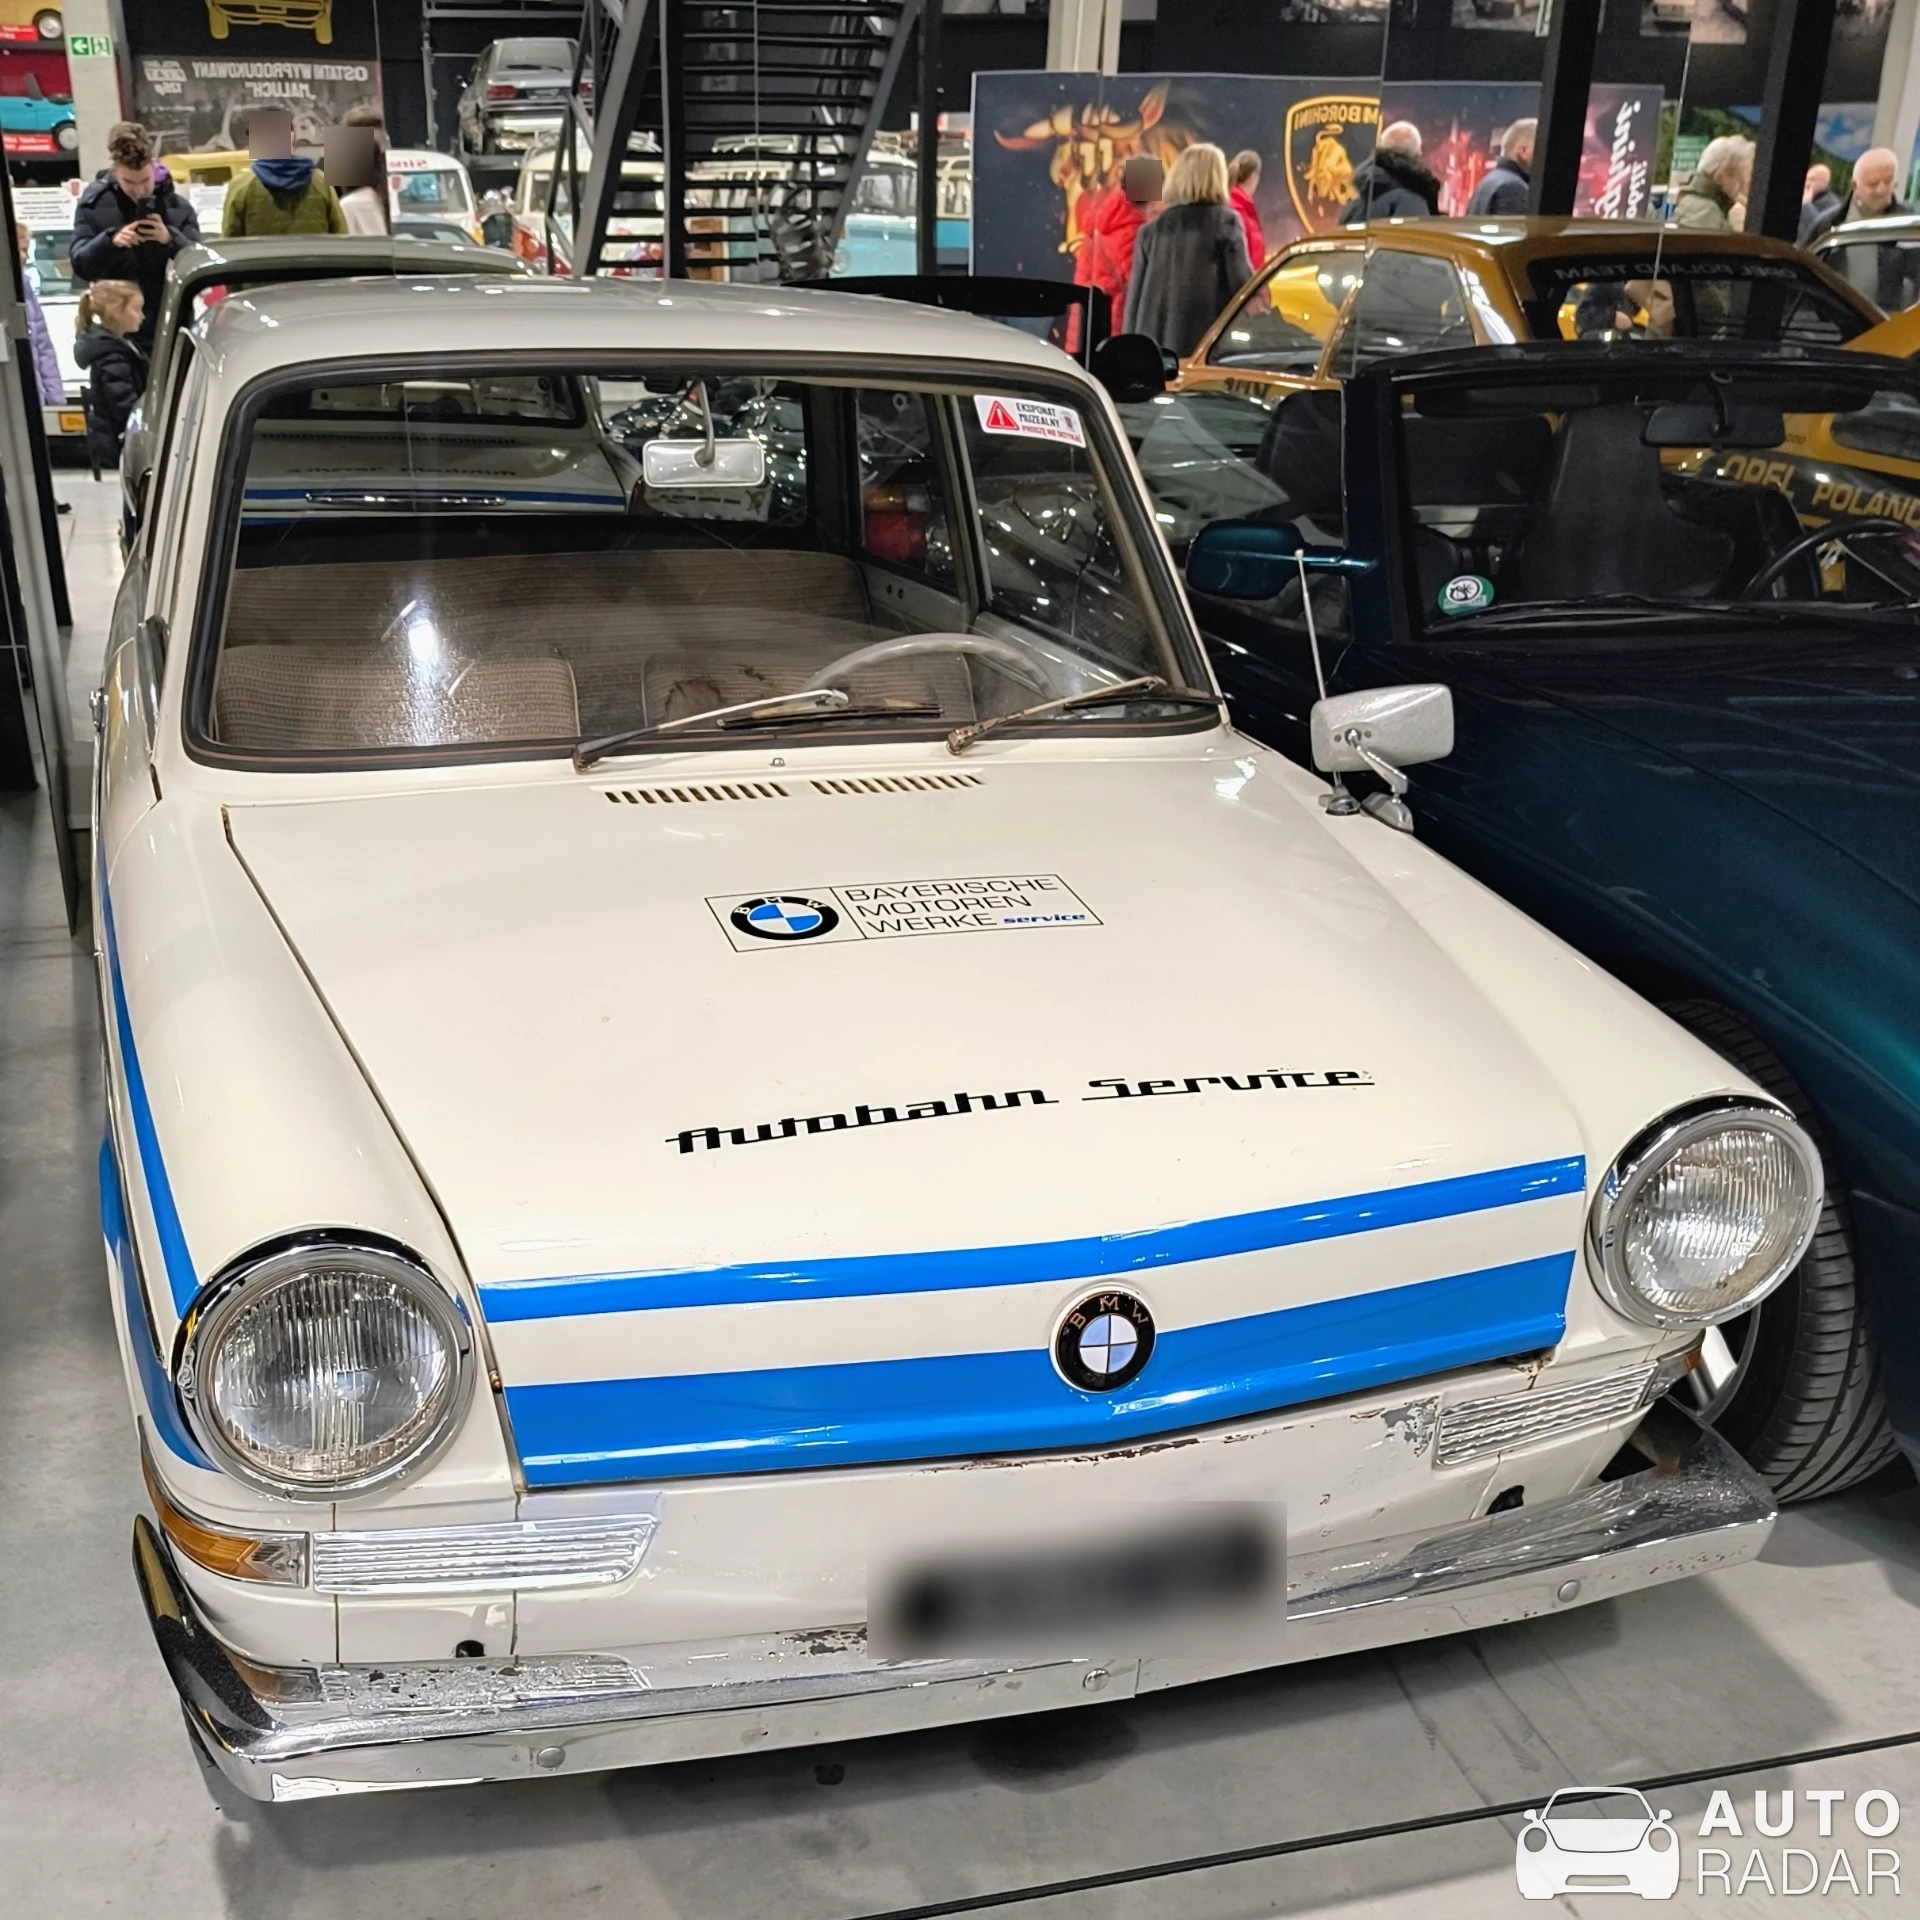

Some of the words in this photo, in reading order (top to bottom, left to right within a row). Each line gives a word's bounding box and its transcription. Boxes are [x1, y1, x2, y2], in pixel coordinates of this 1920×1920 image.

[844, 877, 1059, 902] BAYERISCHE
[855, 894, 1032, 917] MOTOREN
[866, 913, 998, 934] WERKE
[1003, 913, 1085, 925] service
[665, 1088, 1059, 1154] Autobahn
[1081, 1070, 1375, 1101] Service
[1069, 1296, 1149, 1330] BMW
